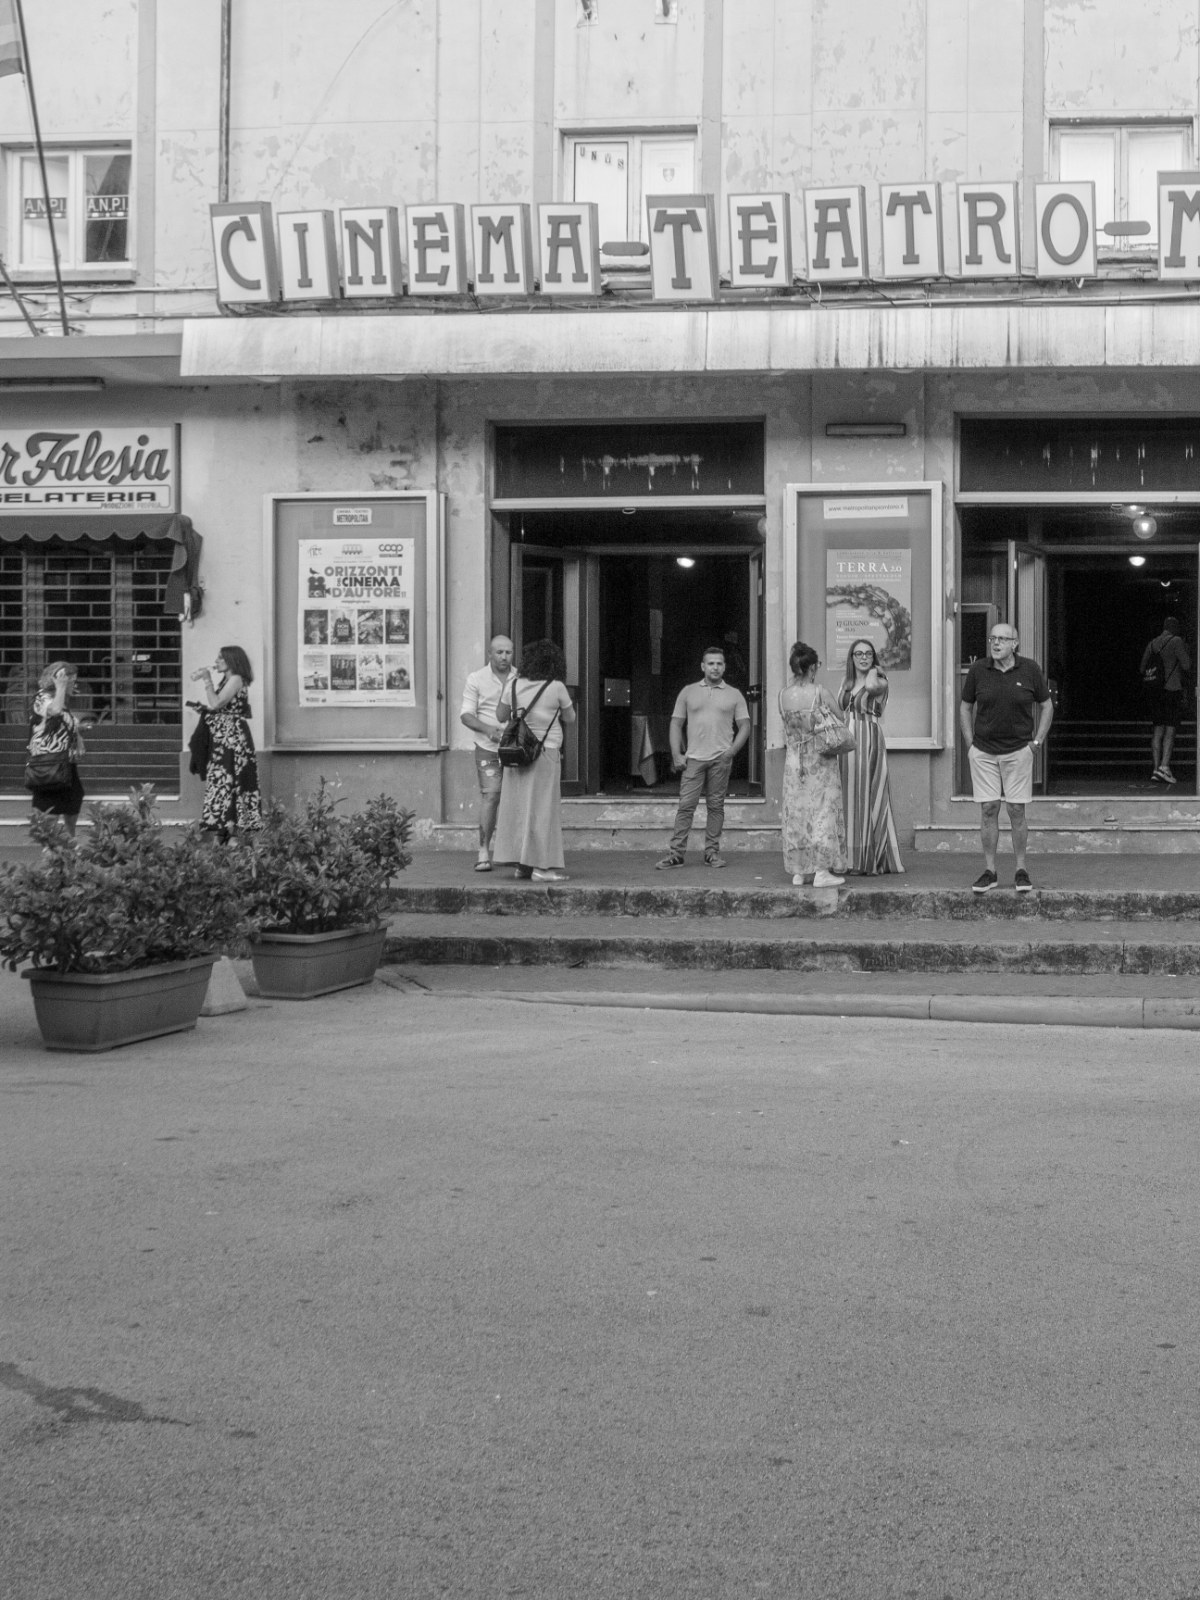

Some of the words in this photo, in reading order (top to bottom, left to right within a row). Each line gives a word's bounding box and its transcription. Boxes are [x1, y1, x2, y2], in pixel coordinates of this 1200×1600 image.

[25, 198, 67, 212] A.NP.I.
[220, 212, 589, 290] CINEMA
[653, 190, 1089, 289] TEATRO
[22, 430, 171, 486] Falesia
[0, 491, 157, 503] ELATERIA
[378, 544, 404, 554] coop
[324, 565, 403, 576] ORIZZONTI
[837, 562, 888, 573] TERRA
[342, 576, 400, 587] CINEMA
